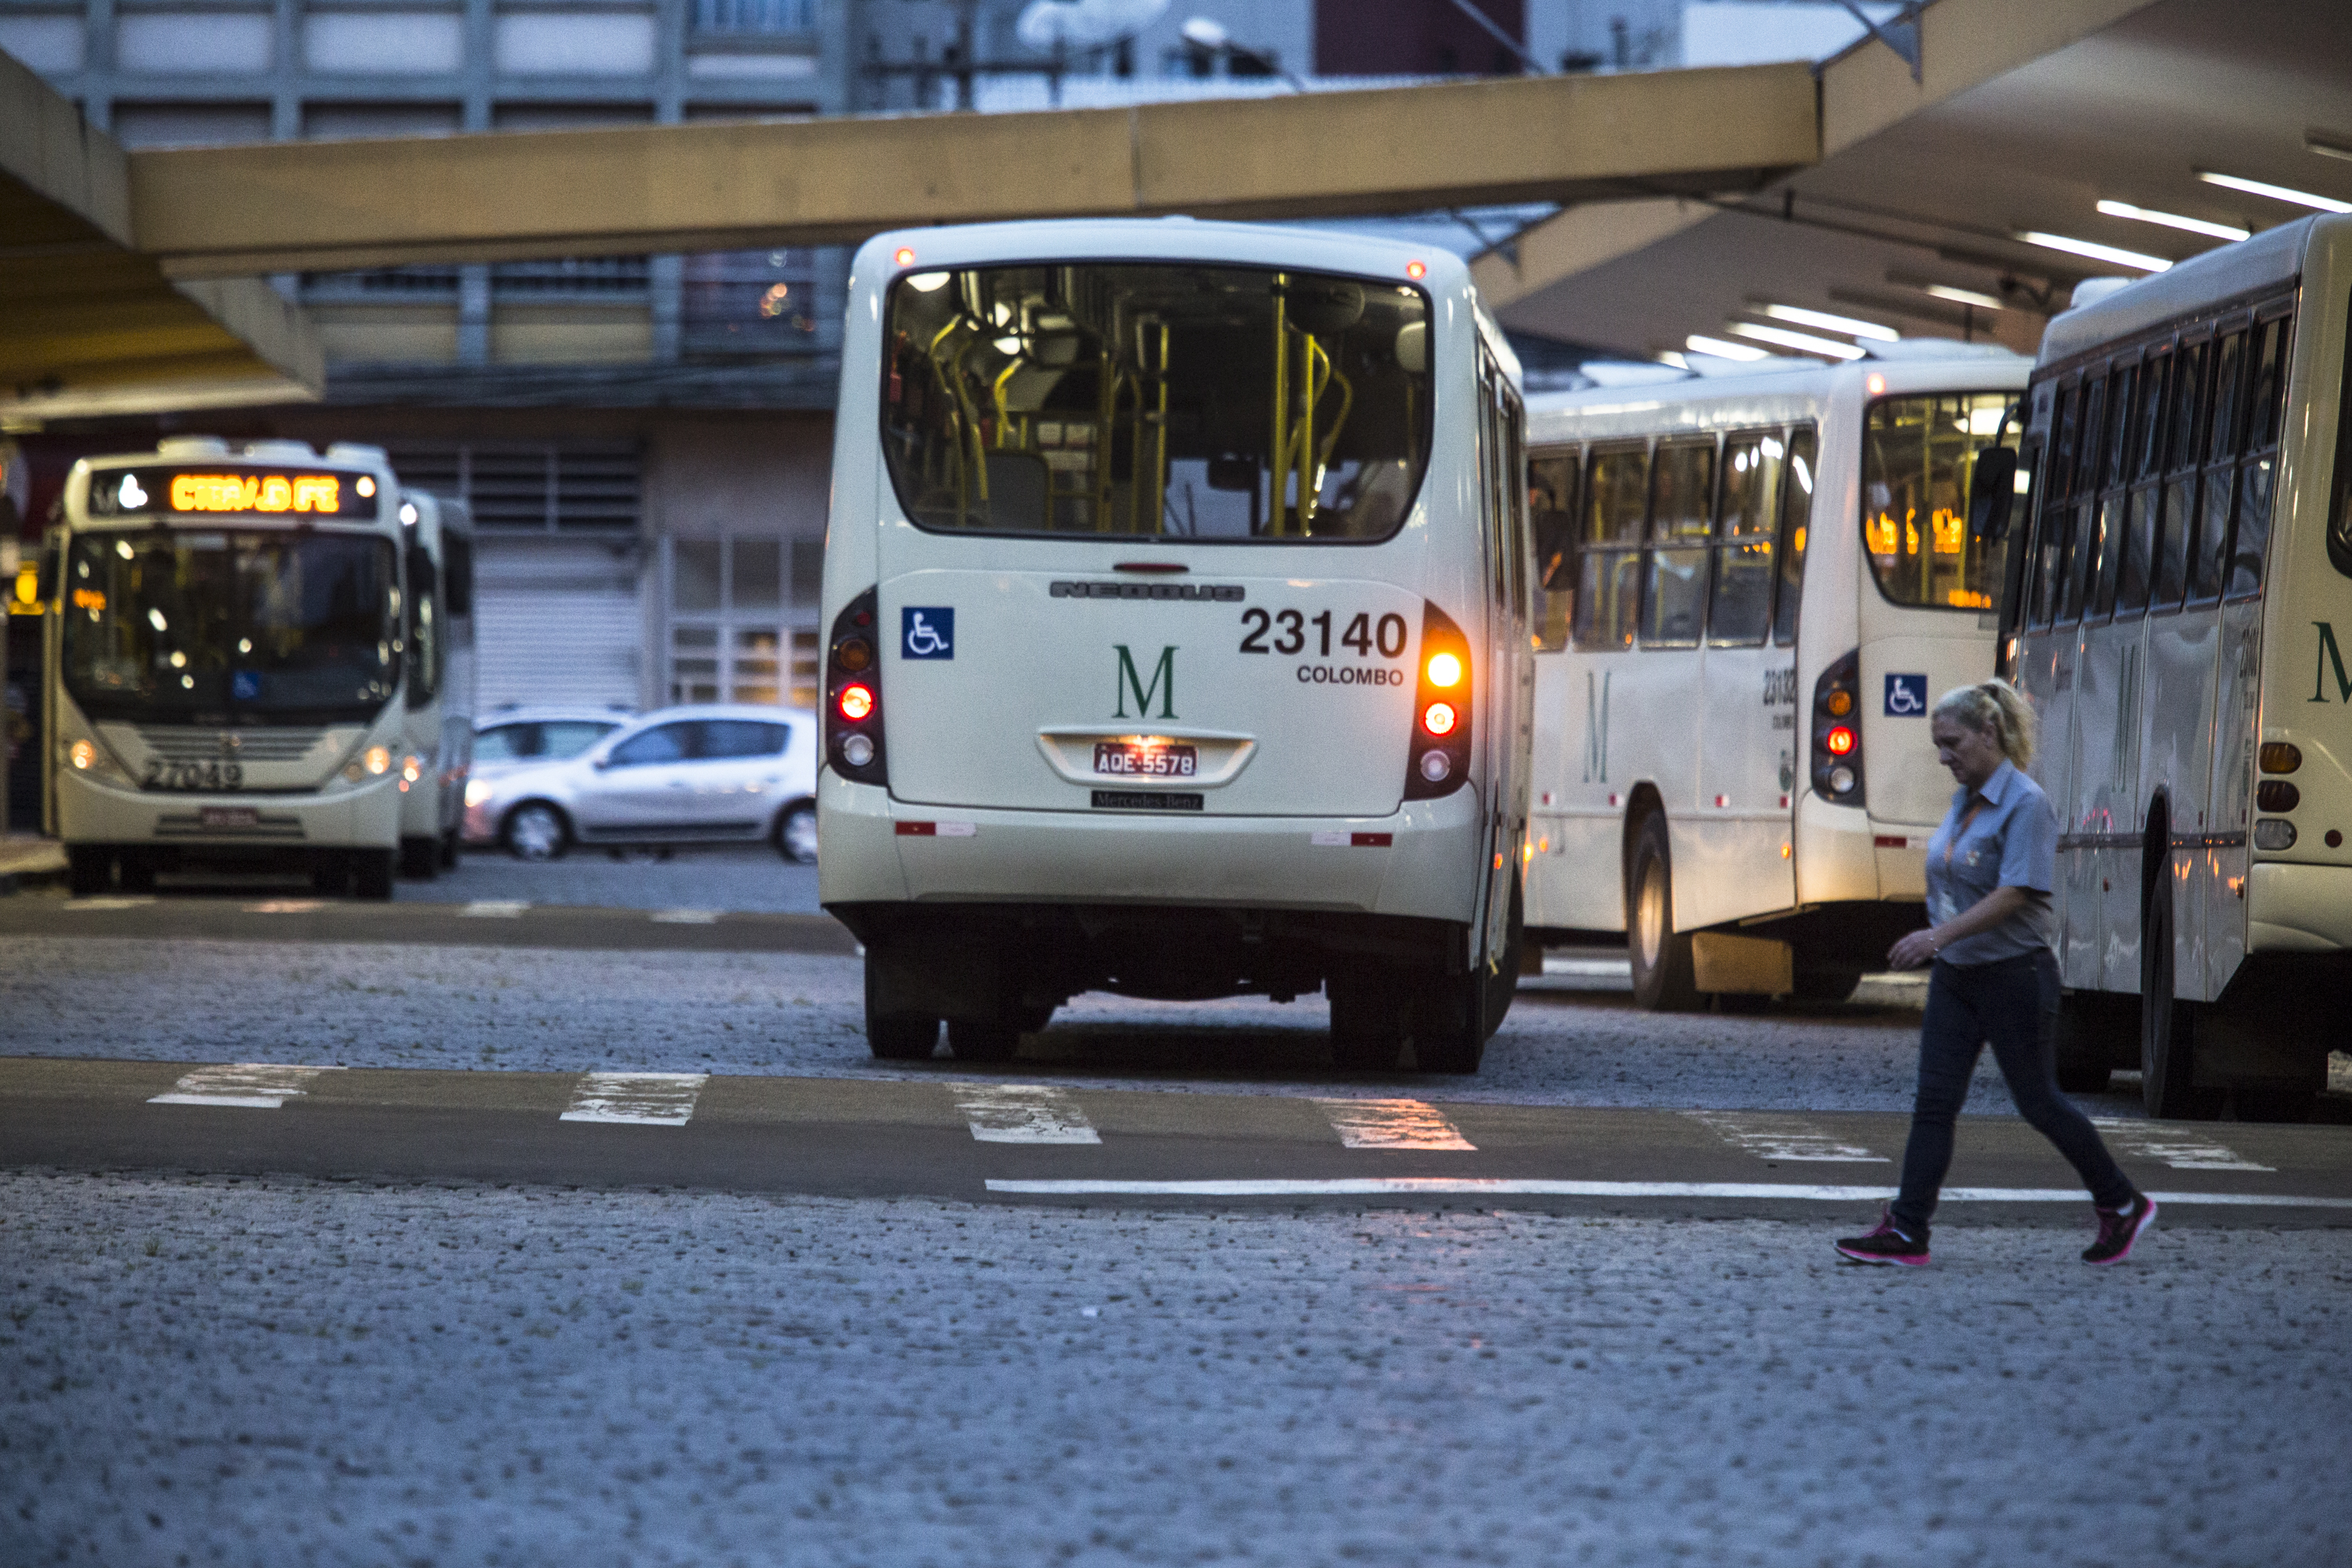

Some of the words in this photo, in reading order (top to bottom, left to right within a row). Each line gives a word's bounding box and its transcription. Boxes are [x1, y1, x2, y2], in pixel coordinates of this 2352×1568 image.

[1239, 607, 1407, 659] 23140
[1110, 644, 1181, 719] M
[1296, 666, 1404, 688] COLOMBO
